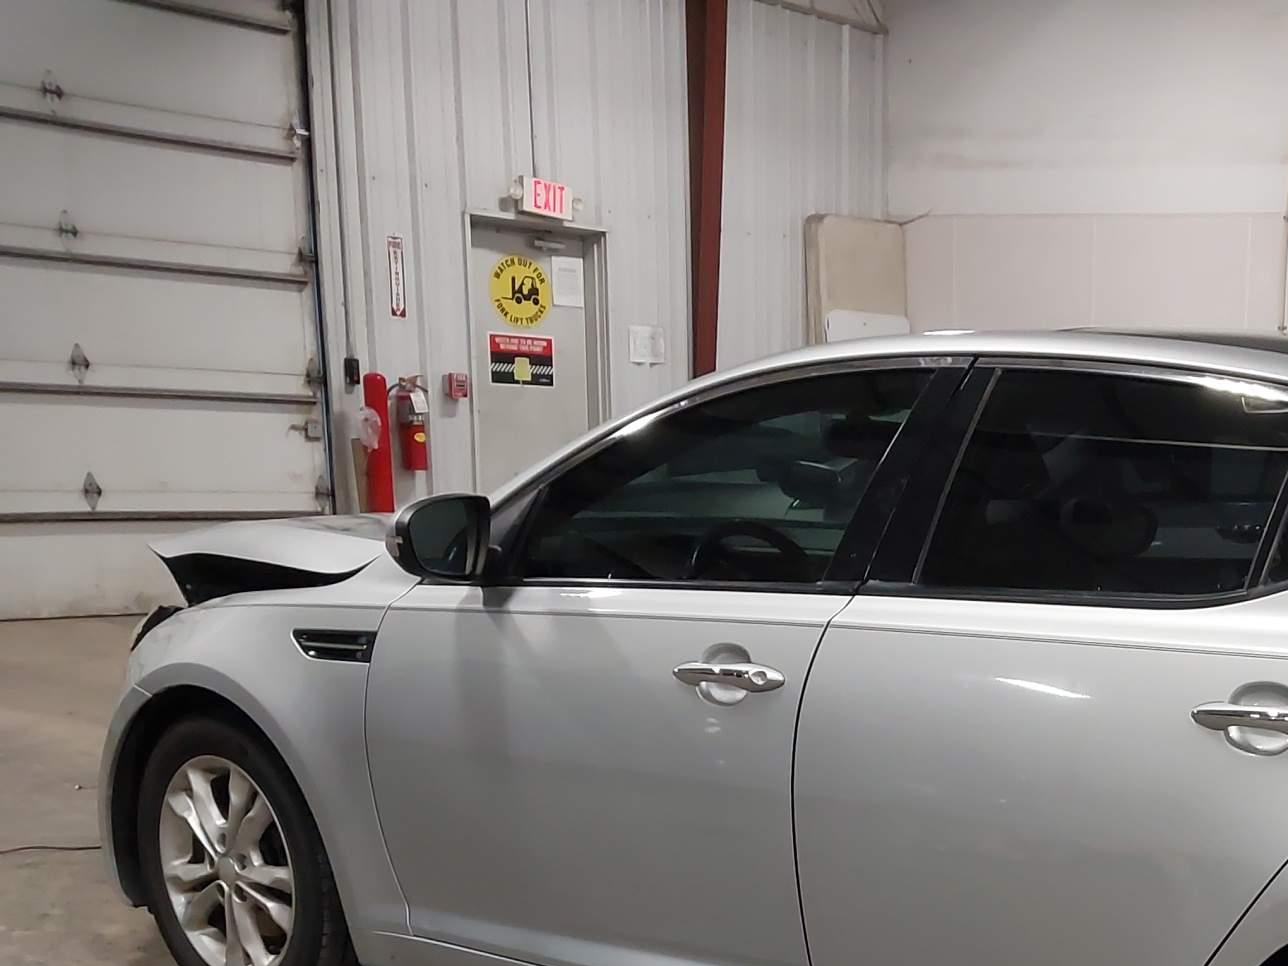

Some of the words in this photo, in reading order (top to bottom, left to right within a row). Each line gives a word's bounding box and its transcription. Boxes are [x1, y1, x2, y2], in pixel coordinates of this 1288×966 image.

[533, 180, 565, 214] EXIT
[494, 257, 515, 280] WATCH
[517, 257, 532, 269] OUT
[533, 267, 546, 285] FOR
[494, 299, 510, 317] FORK
[509, 314, 523, 325] LIFT
